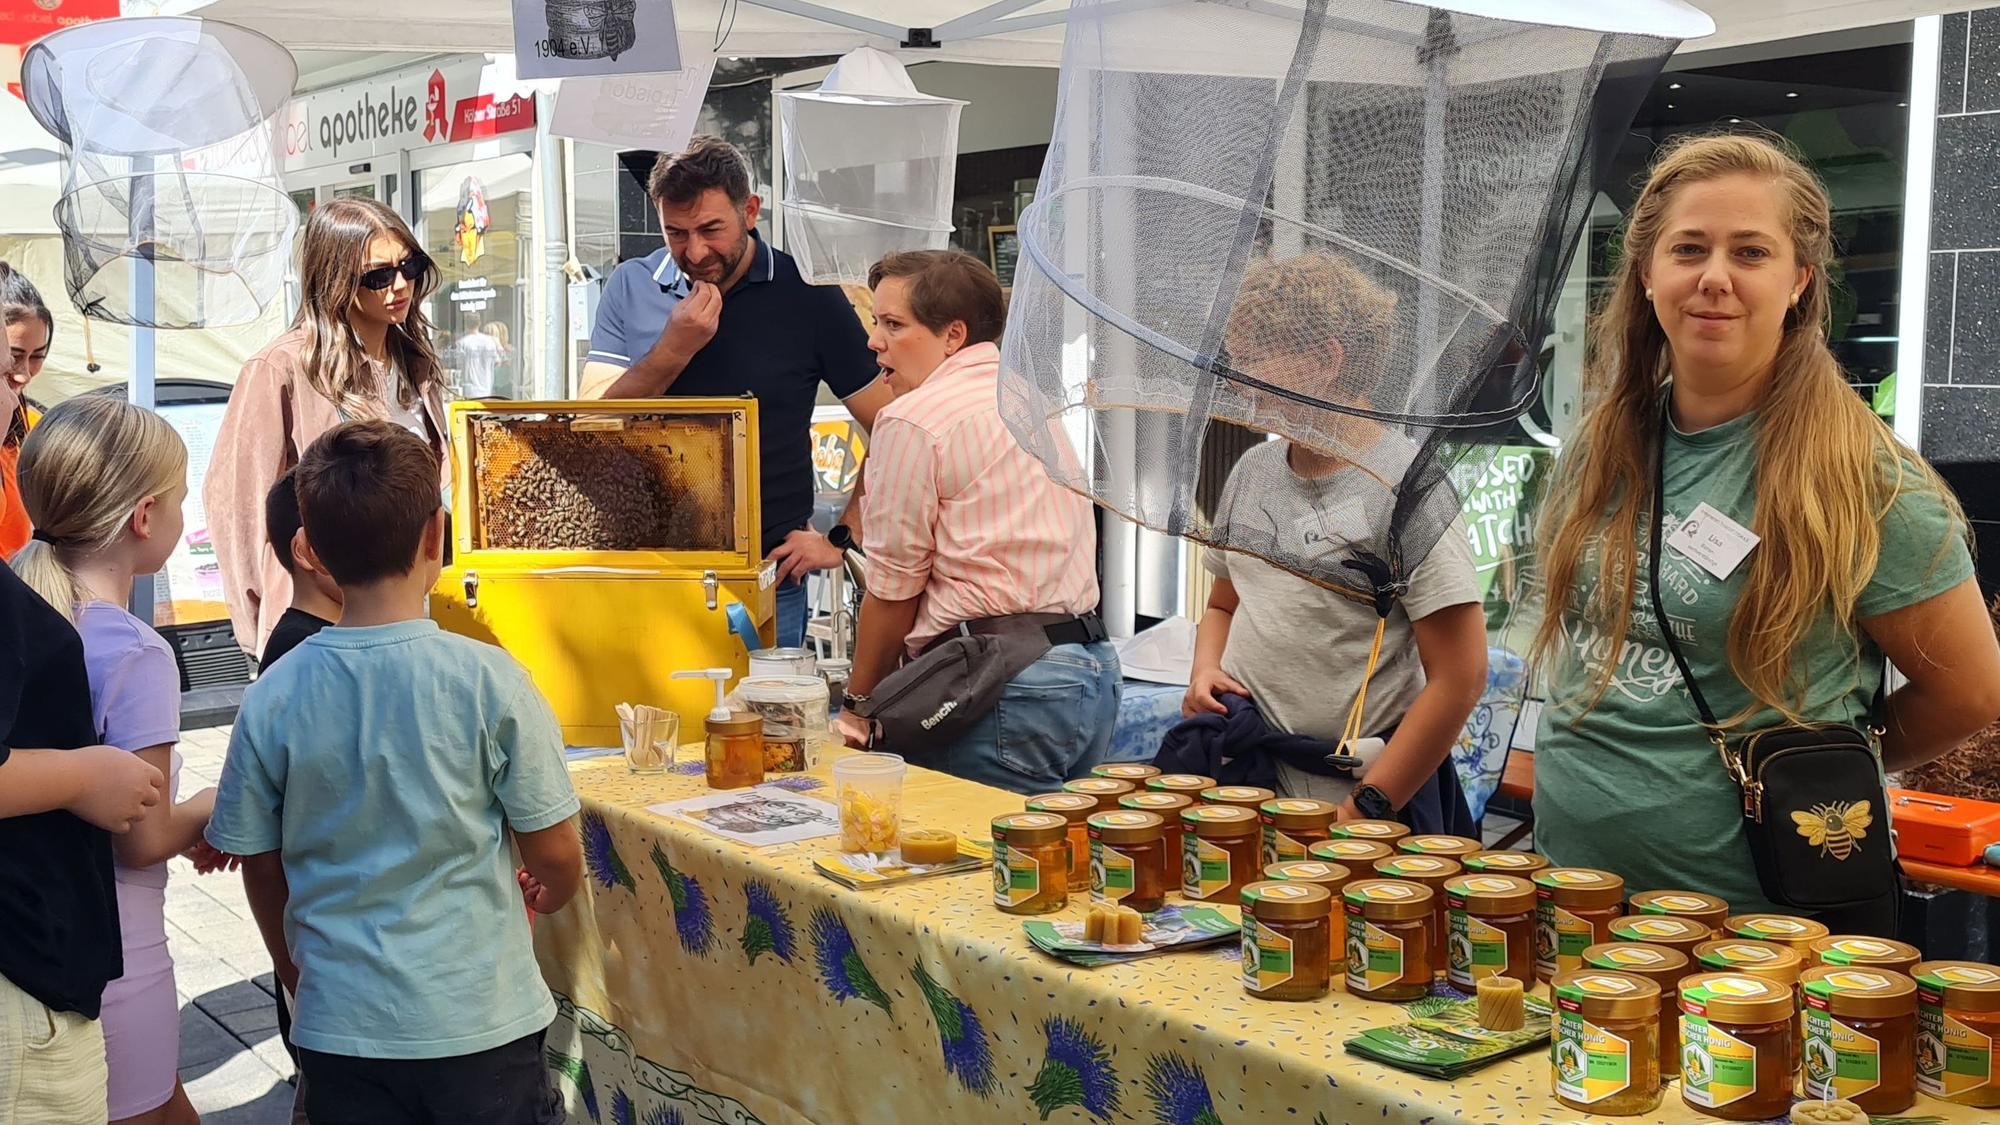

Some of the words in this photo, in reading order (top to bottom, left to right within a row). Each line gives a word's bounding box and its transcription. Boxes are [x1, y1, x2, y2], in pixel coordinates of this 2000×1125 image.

[534, 39, 564, 58] 1904
[569, 36, 594, 55] e.V.
[512, 98, 521, 115] 51
[320, 85, 418, 158] apotheke
[733, 411, 742, 421] R
[1471, 485, 1516, 513] WITH
[1467, 513, 1533, 558] ATCH
[1659, 560, 1699, 606] HARD
[1670, 621, 1697, 642] THE
[1577, 1033, 1606, 1044] HONIG
[1826, 1029, 1856, 1043] HONIG
[1937, 1025, 1968, 1039] HONIG
[1703, 1036, 1732, 1049] HONIG
